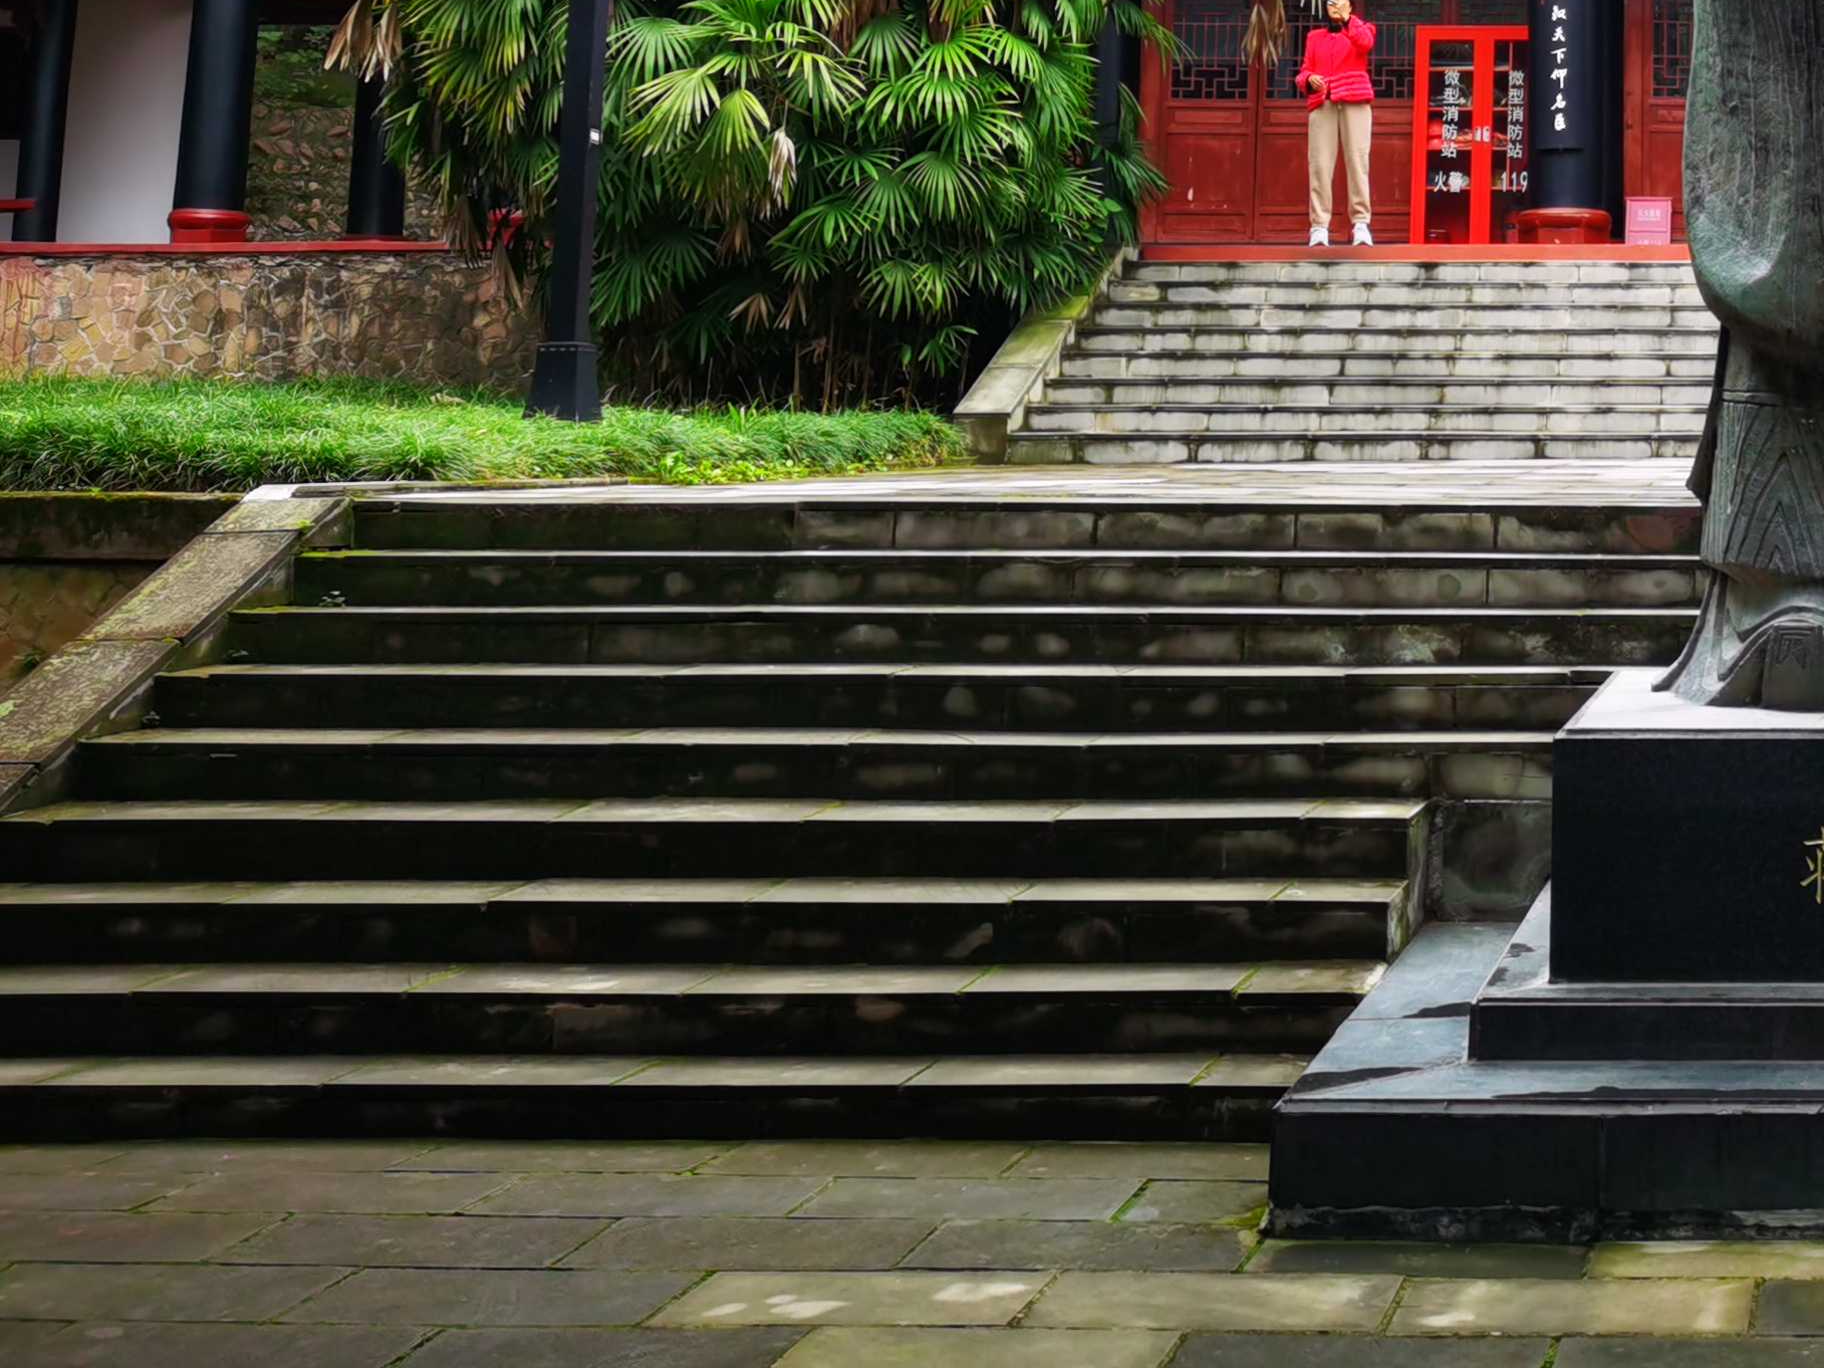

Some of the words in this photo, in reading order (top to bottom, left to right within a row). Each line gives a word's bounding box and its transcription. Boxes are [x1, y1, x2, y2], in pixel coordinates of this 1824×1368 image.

[1440, 70, 1461, 158] 微型消防站
[1507, 70, 1525, 158] 微型消防站
[1433, 171, 1463, 193] 火警
[1501, 171, 1528, 193] 119
